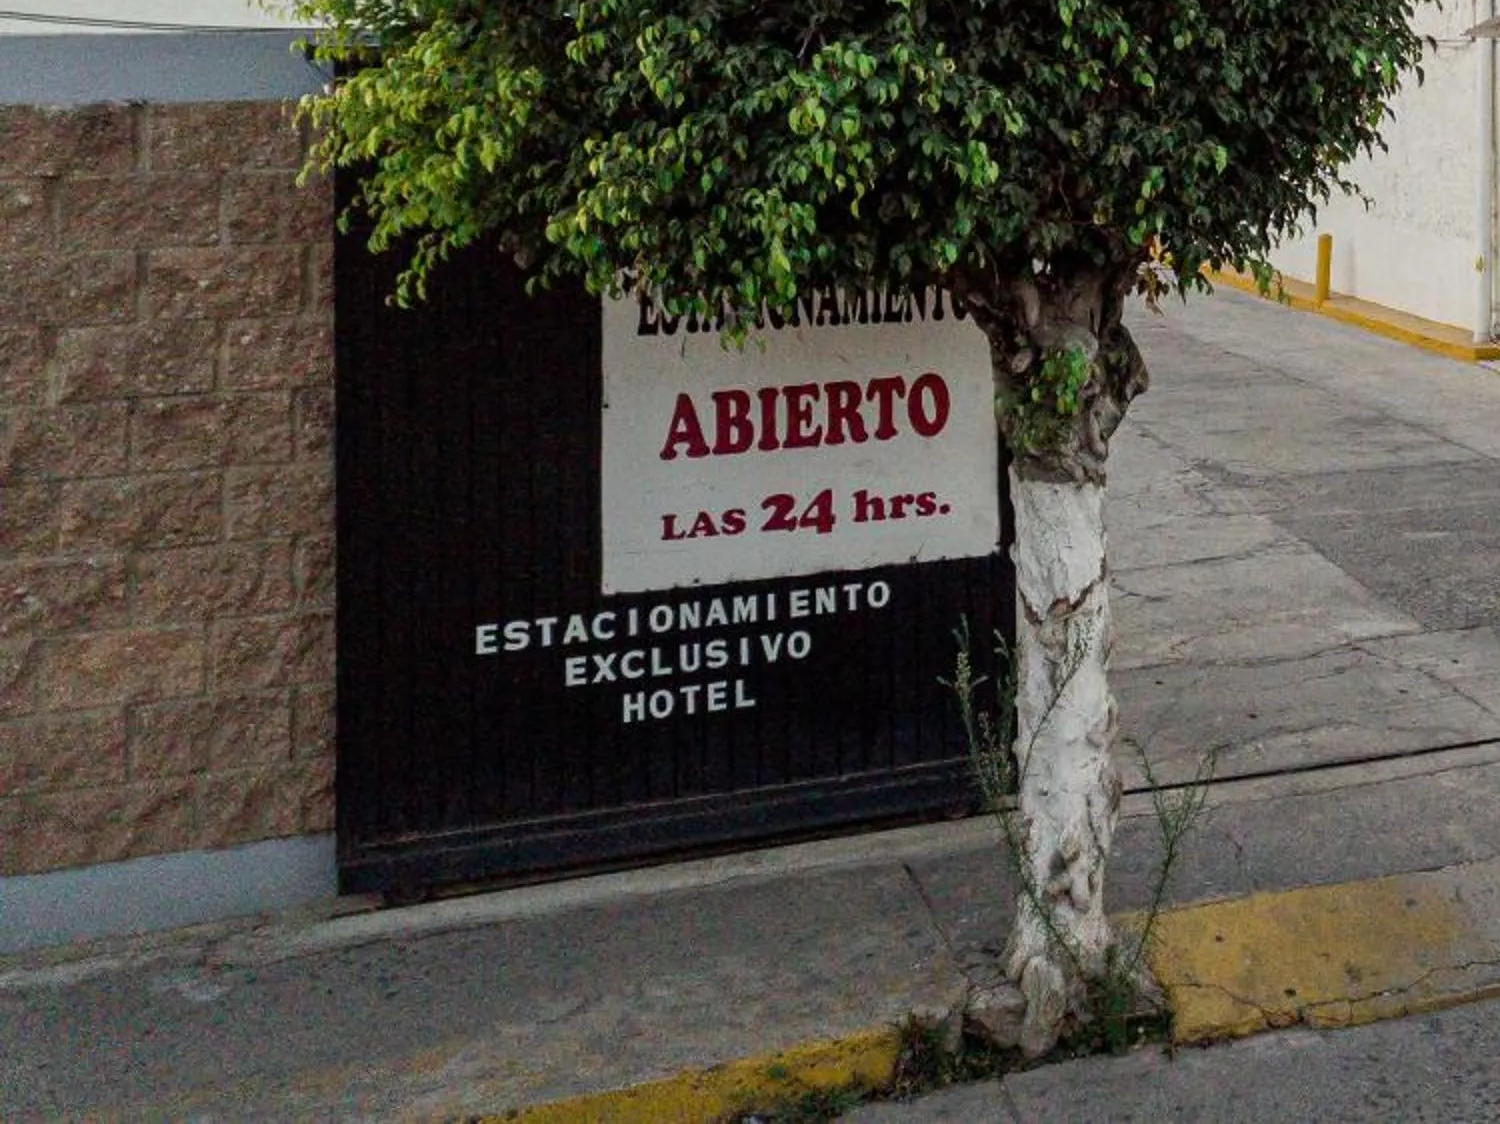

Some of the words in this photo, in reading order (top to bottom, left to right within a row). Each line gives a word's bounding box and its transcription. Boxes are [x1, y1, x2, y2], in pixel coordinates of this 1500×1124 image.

[659, 372, 950, 461] ABIERTO
[660, 507, 747, 541] LAS
[760, 489, 837, 535] 24
[853, 489, 951, 524] hrs.
[474, 579, 892, 657] ESTACIONAMIENTO
[564, 630, 812, 688] EXCLUSIVO
[622, 678, 757, 724] HOTEL
